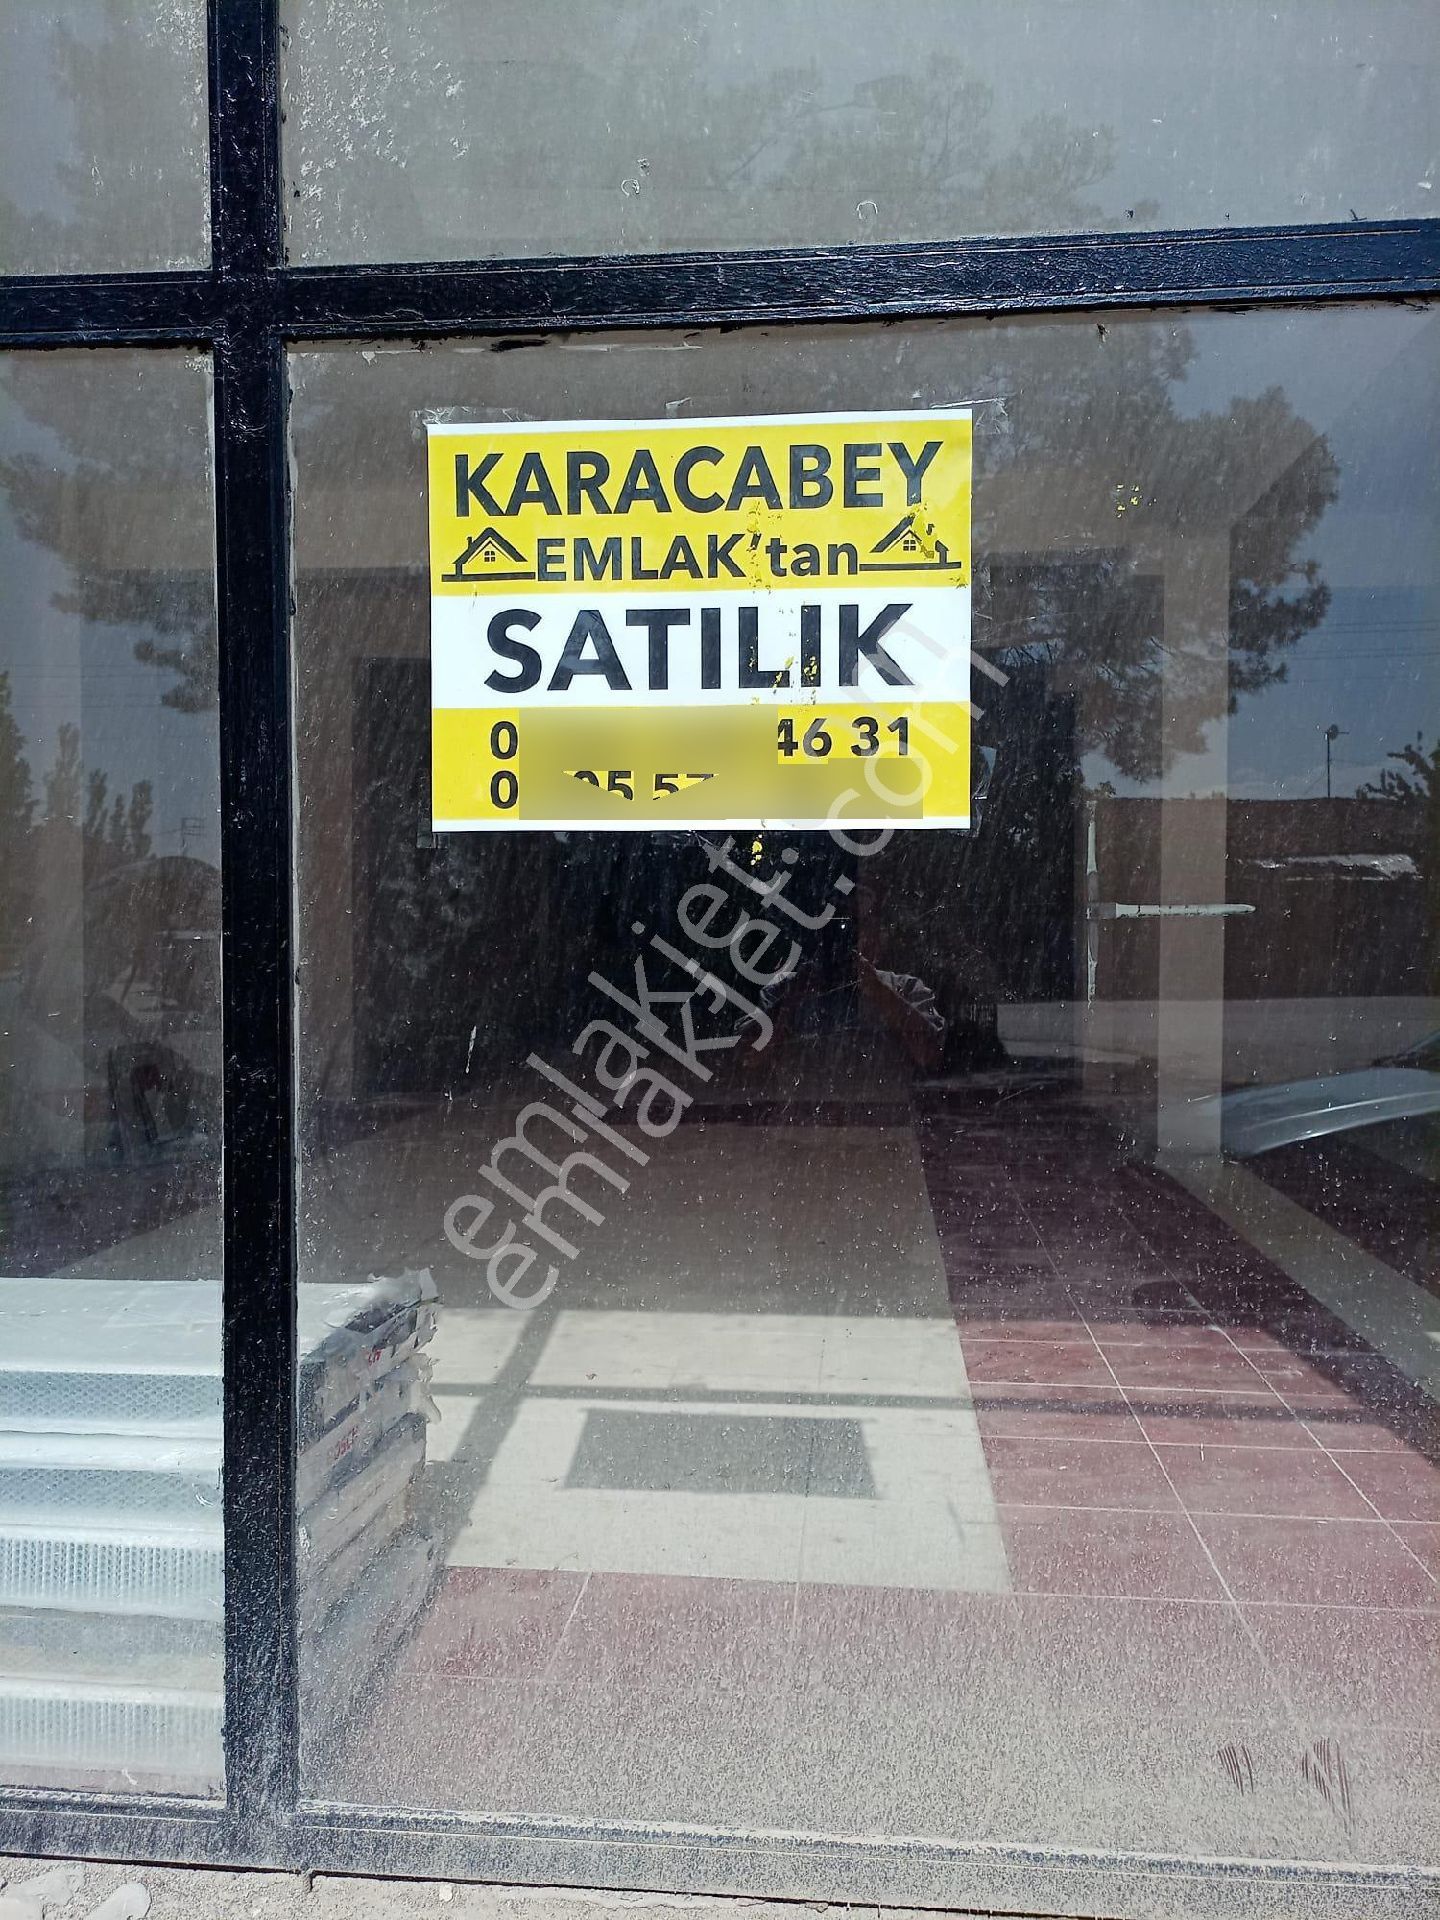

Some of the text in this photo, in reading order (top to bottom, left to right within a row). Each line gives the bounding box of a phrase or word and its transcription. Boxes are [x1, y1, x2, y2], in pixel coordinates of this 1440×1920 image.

[455, 441, 943, 517] KARACABEY
[537, 533, 858, 582] EMLAK'tan
[484, 603, 914, 693] SATILIK
[850, 716, 909, 756] 31
